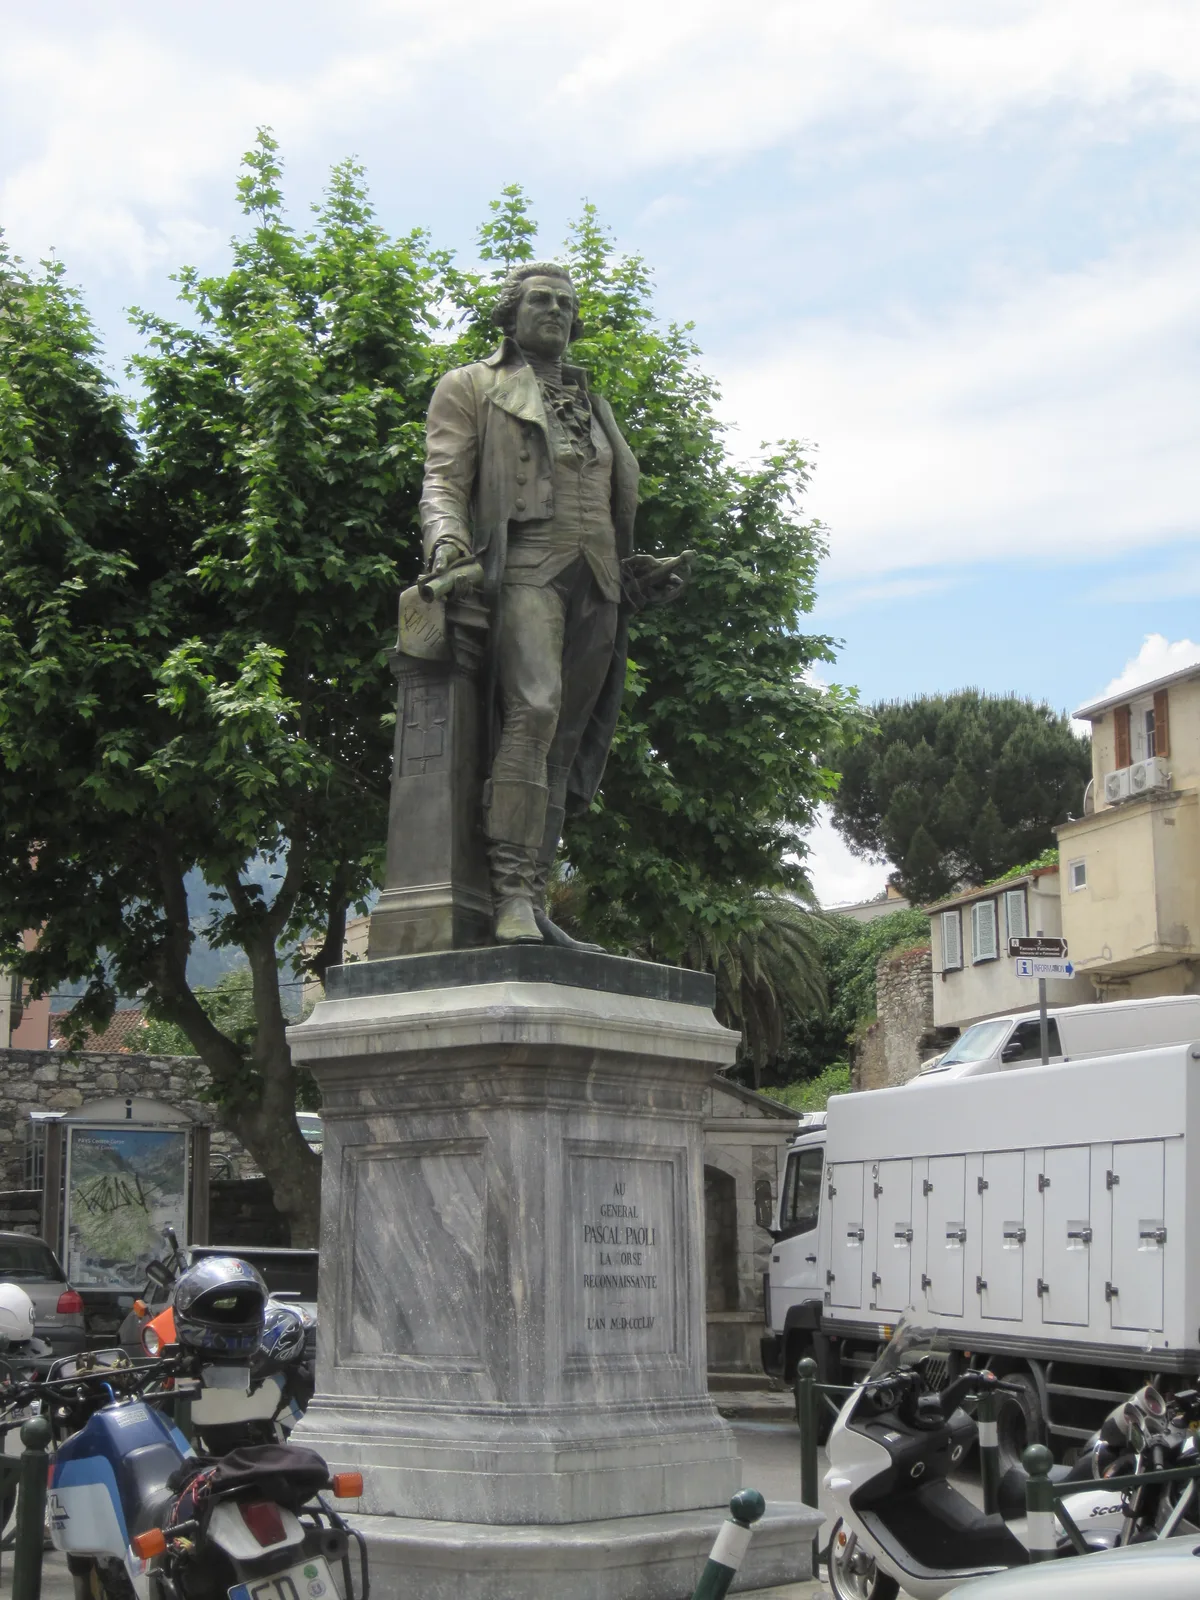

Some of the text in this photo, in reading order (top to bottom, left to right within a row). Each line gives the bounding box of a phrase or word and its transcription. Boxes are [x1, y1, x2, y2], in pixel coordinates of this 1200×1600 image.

[1034, 964, 1065, 973] INFORMATION
[613, 1182, 626, 1196] AU
[600, 1204, 638, 1218] GENERAL
[584, 1225, 655, 1246] PASCAL PAOLI
[600, 1252, 612, 1266] LA
[583, 1274, 657, 1289] RECONNAISSANTE
[587, 1317, 606, 1330] L'AN
